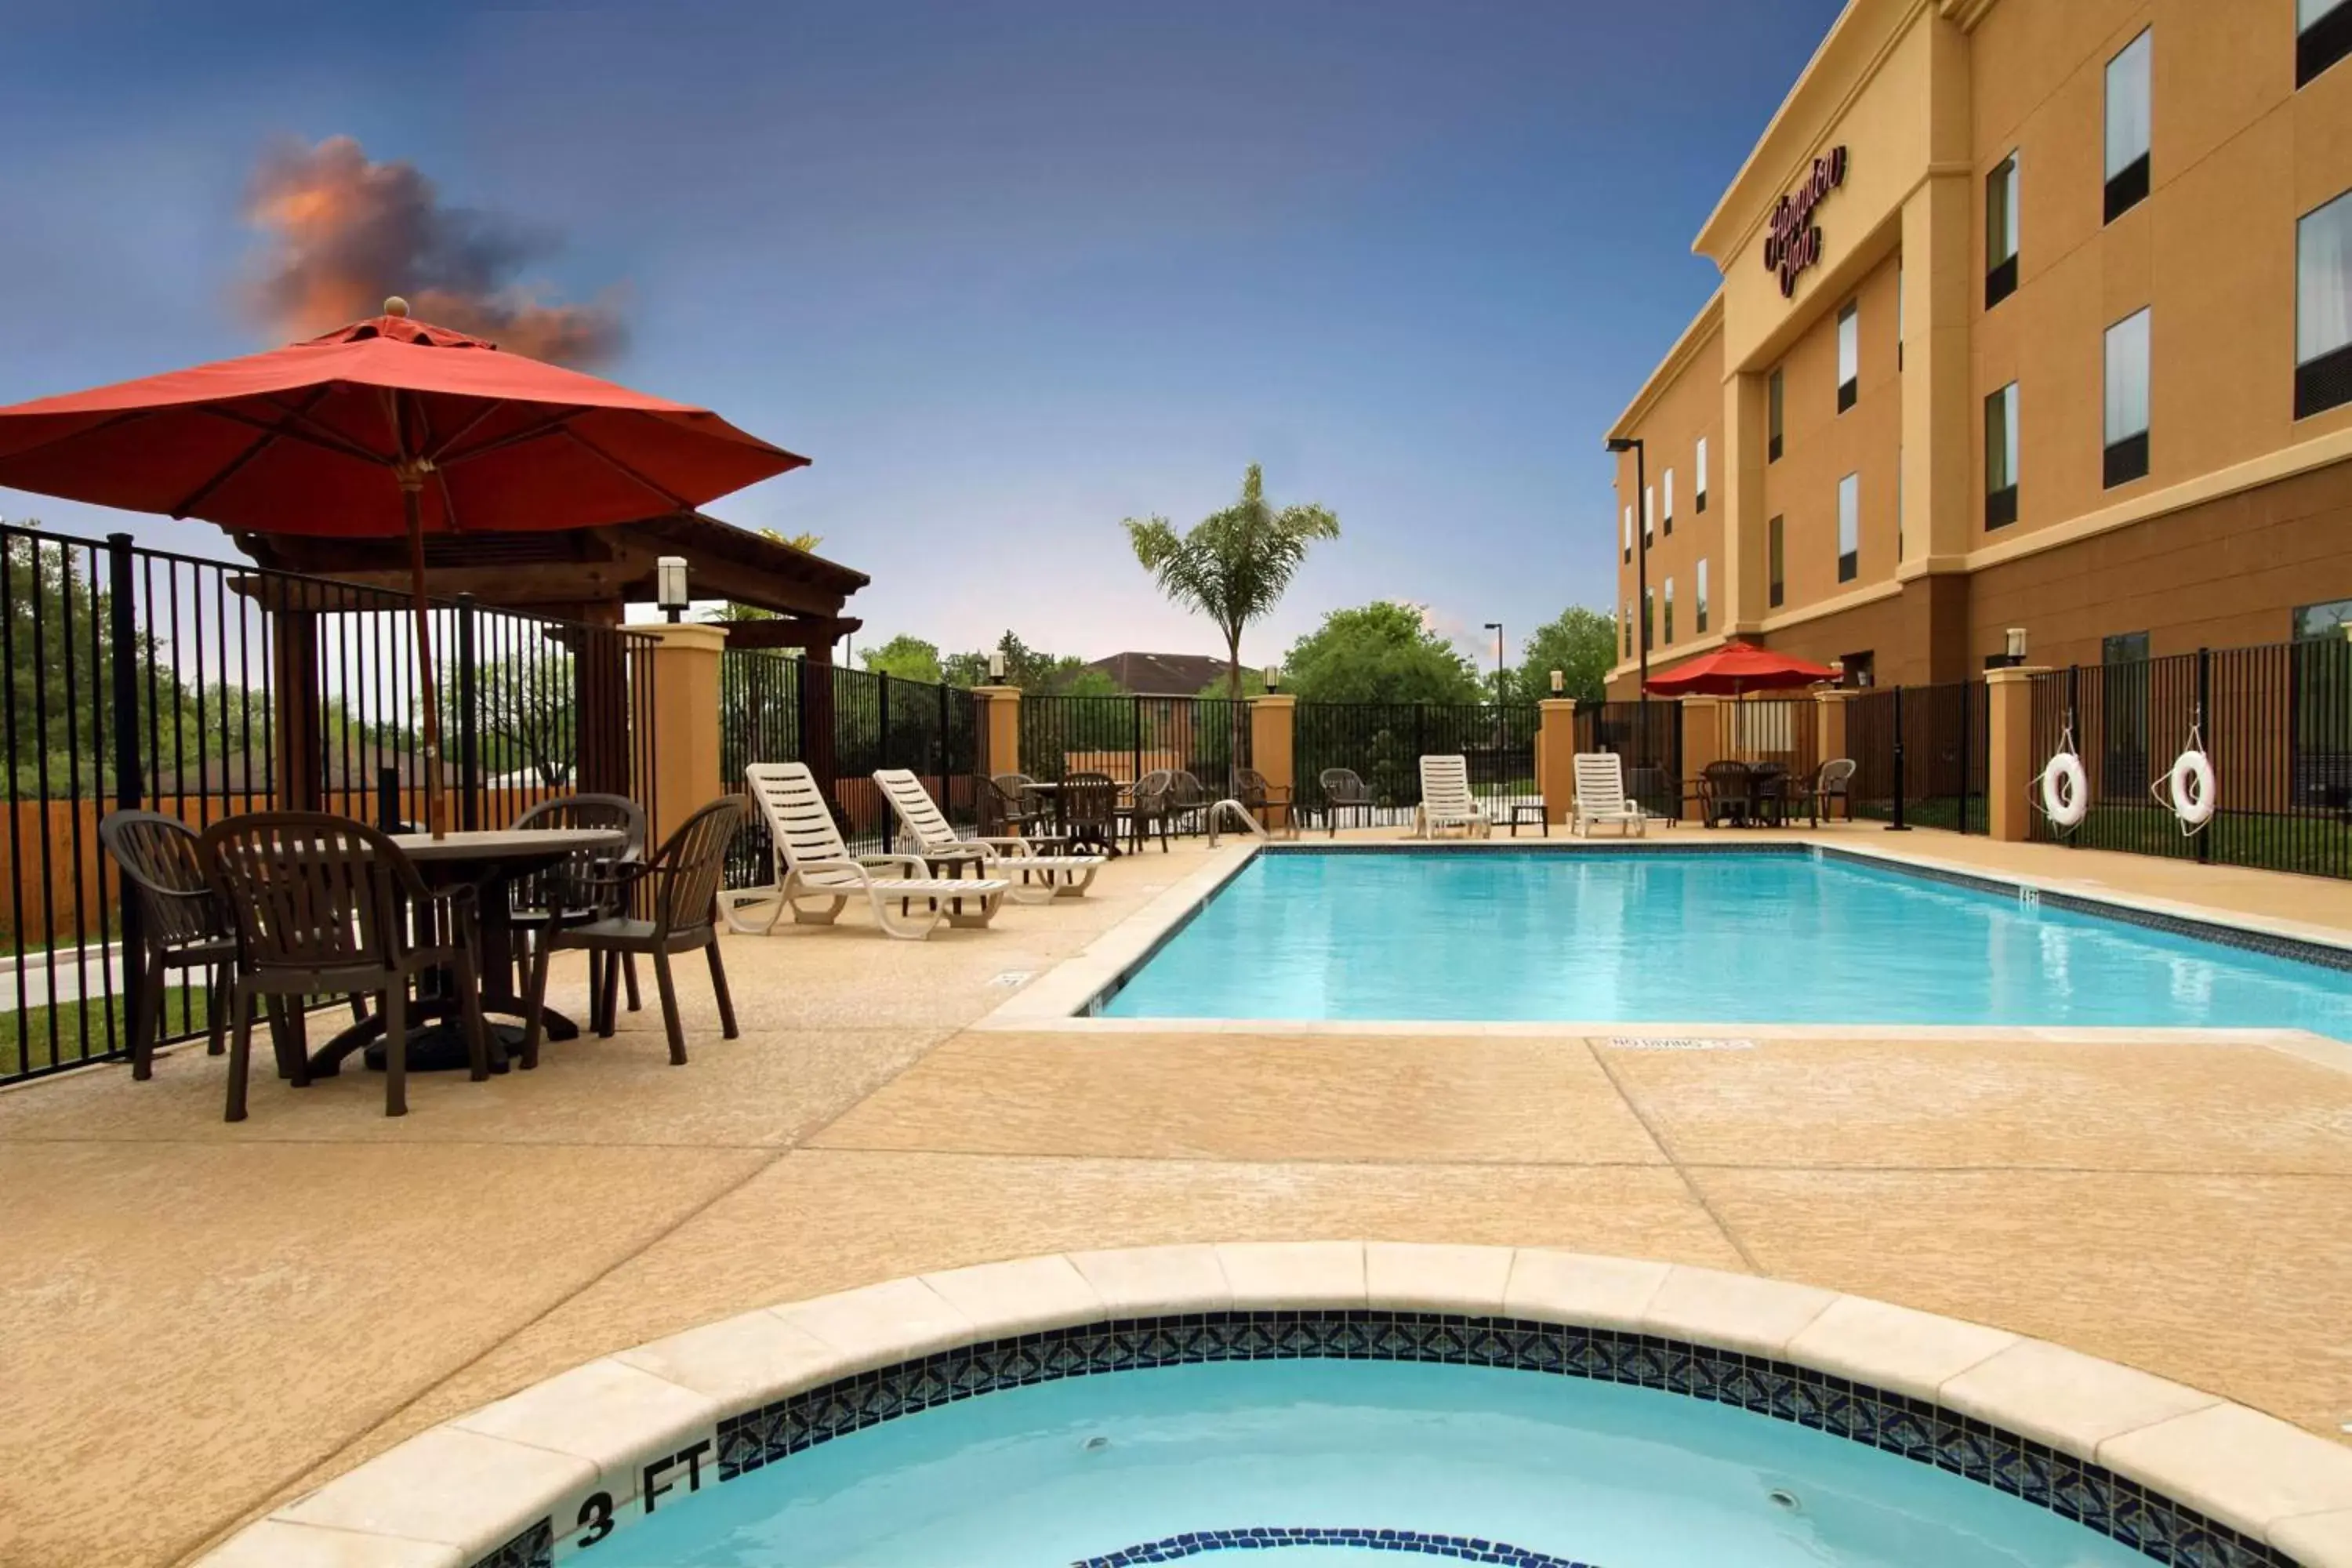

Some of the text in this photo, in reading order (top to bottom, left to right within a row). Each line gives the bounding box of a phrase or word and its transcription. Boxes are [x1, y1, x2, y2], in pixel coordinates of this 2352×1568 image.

[1765, 145, 1846, 271] Hampton
[1780, 226, 1821, 298] Inn
[577, 1439, 710, 1548] 3 FT
